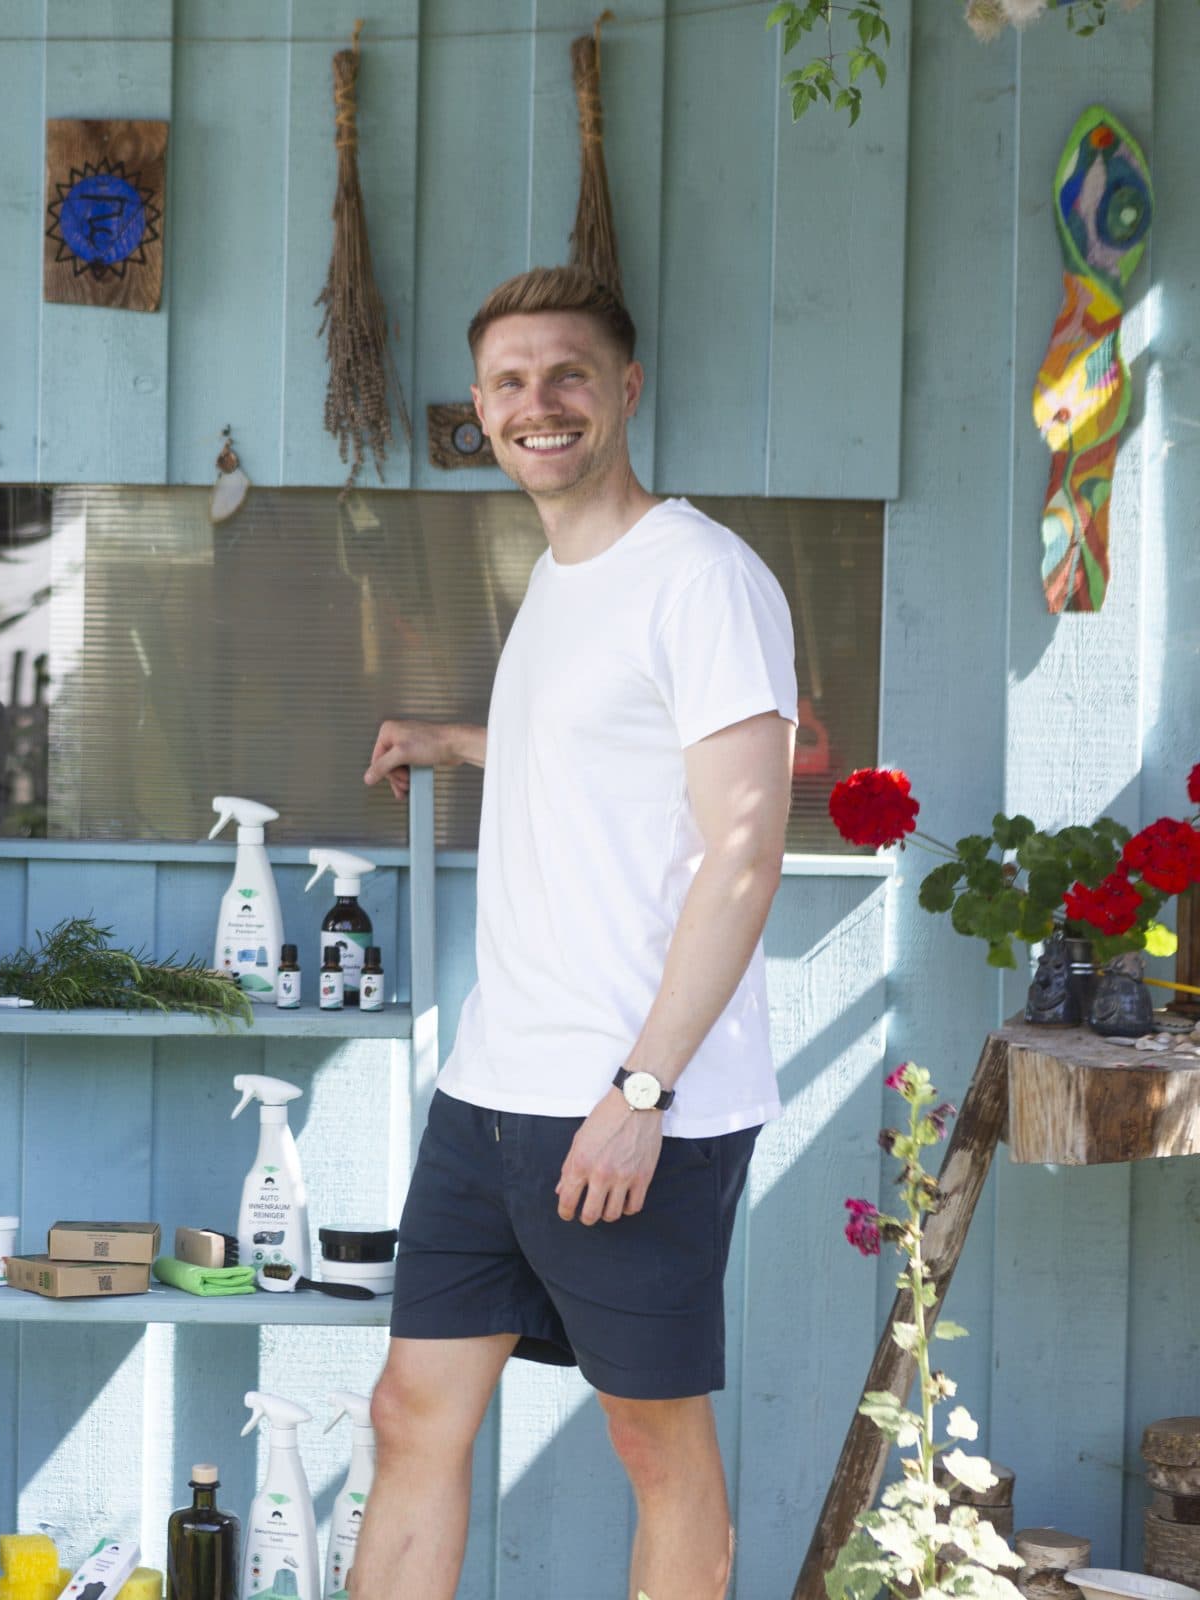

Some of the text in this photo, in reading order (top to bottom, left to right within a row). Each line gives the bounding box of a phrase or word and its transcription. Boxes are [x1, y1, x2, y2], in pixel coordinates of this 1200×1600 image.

[260, 1194, 279, 1202] AUTO
[248, 1203, 291, 1211] INNENRAUM
[253, 1211, 285, 1219] REINIGER
